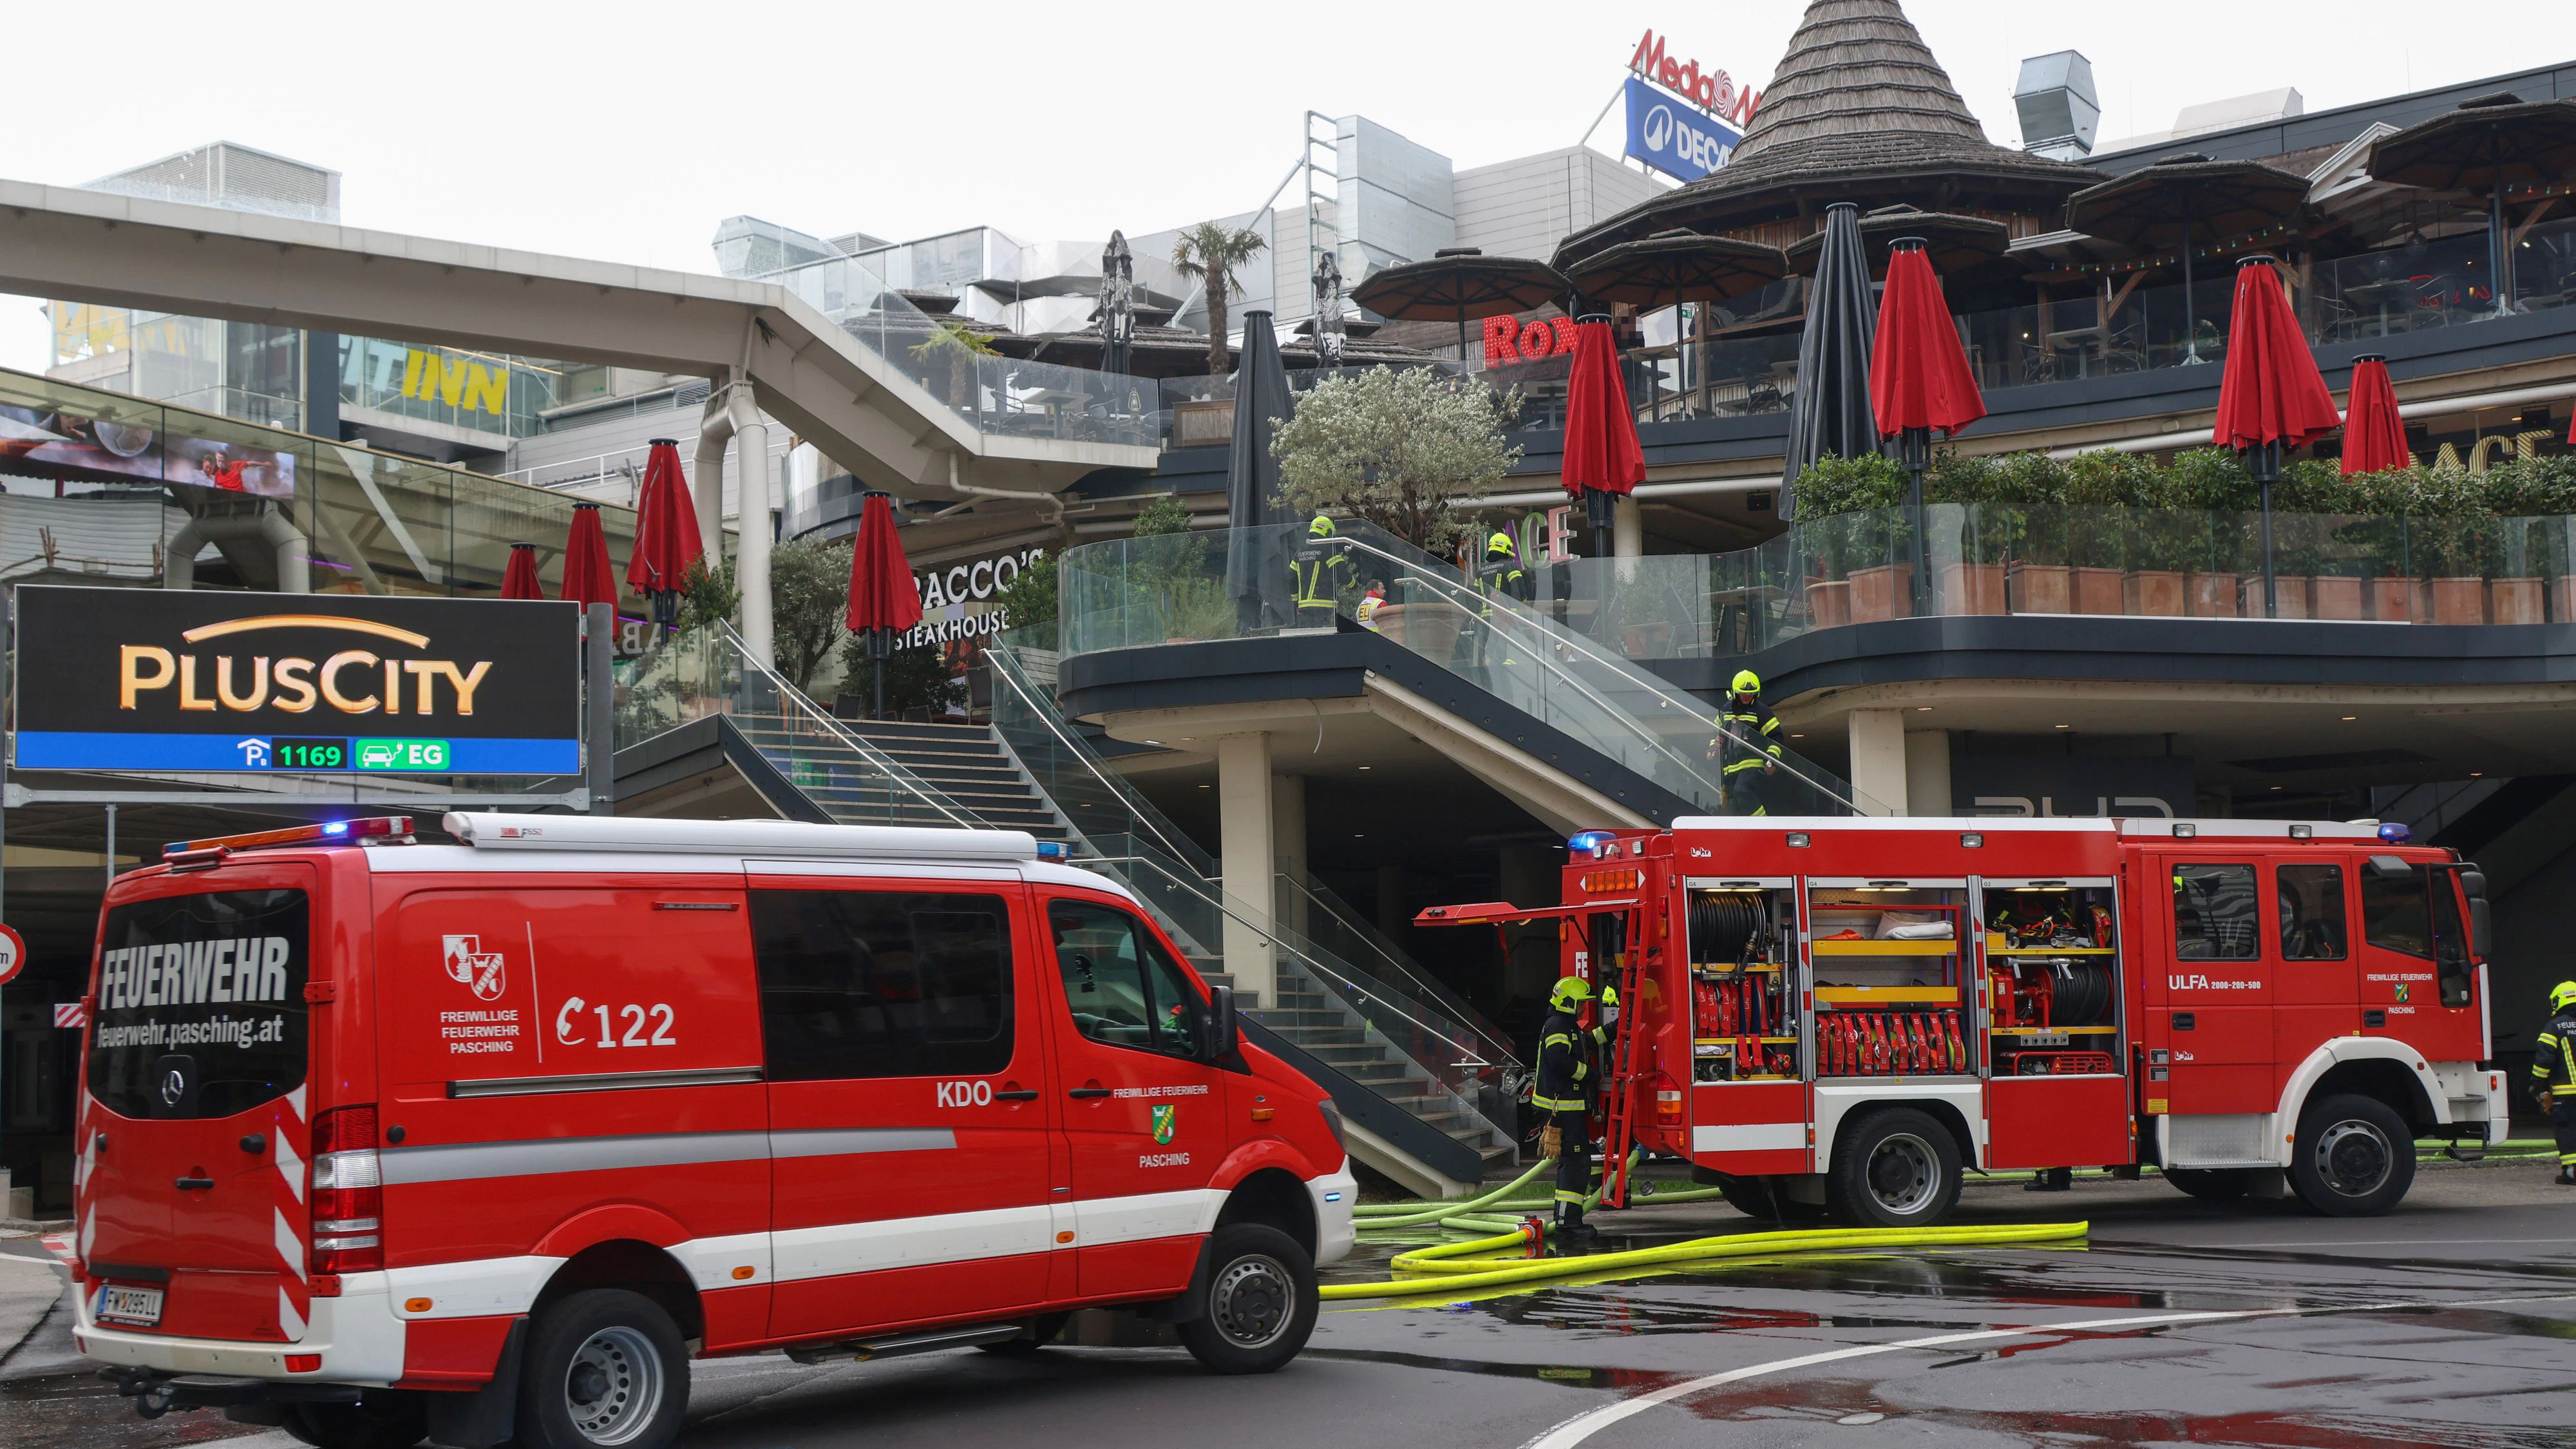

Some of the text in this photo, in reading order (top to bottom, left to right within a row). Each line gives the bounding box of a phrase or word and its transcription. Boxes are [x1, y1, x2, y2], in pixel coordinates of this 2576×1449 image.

[1677, 120, 1734, 174] DECA
[280, 746, 341, 766] 1169
[408, 744, 443, 764] EG
[100, 936, 290, 1010] FEUERWEHR
[1575, 951, 1588, 978] FE
[2168, 974, 2261, 990] ULFA 2000-200-500
[440, 1010, 518, 1023] FREIWILLIGE
[593, 1003, 676, 1048] 122
[97, 1014, 284, 1050] feuerwehr.pasching.at
[441, 1025, 520, 1038] FEUERWEHR
[450, 1041, 514, 1054] PASCHING
[936, 1080, 992, 1108] KDO
[1113, 1084, 1209, 1098] FREIWILLIGE FEUERWEHR
[1139, 1152, 1190, 1168] PASCHING
